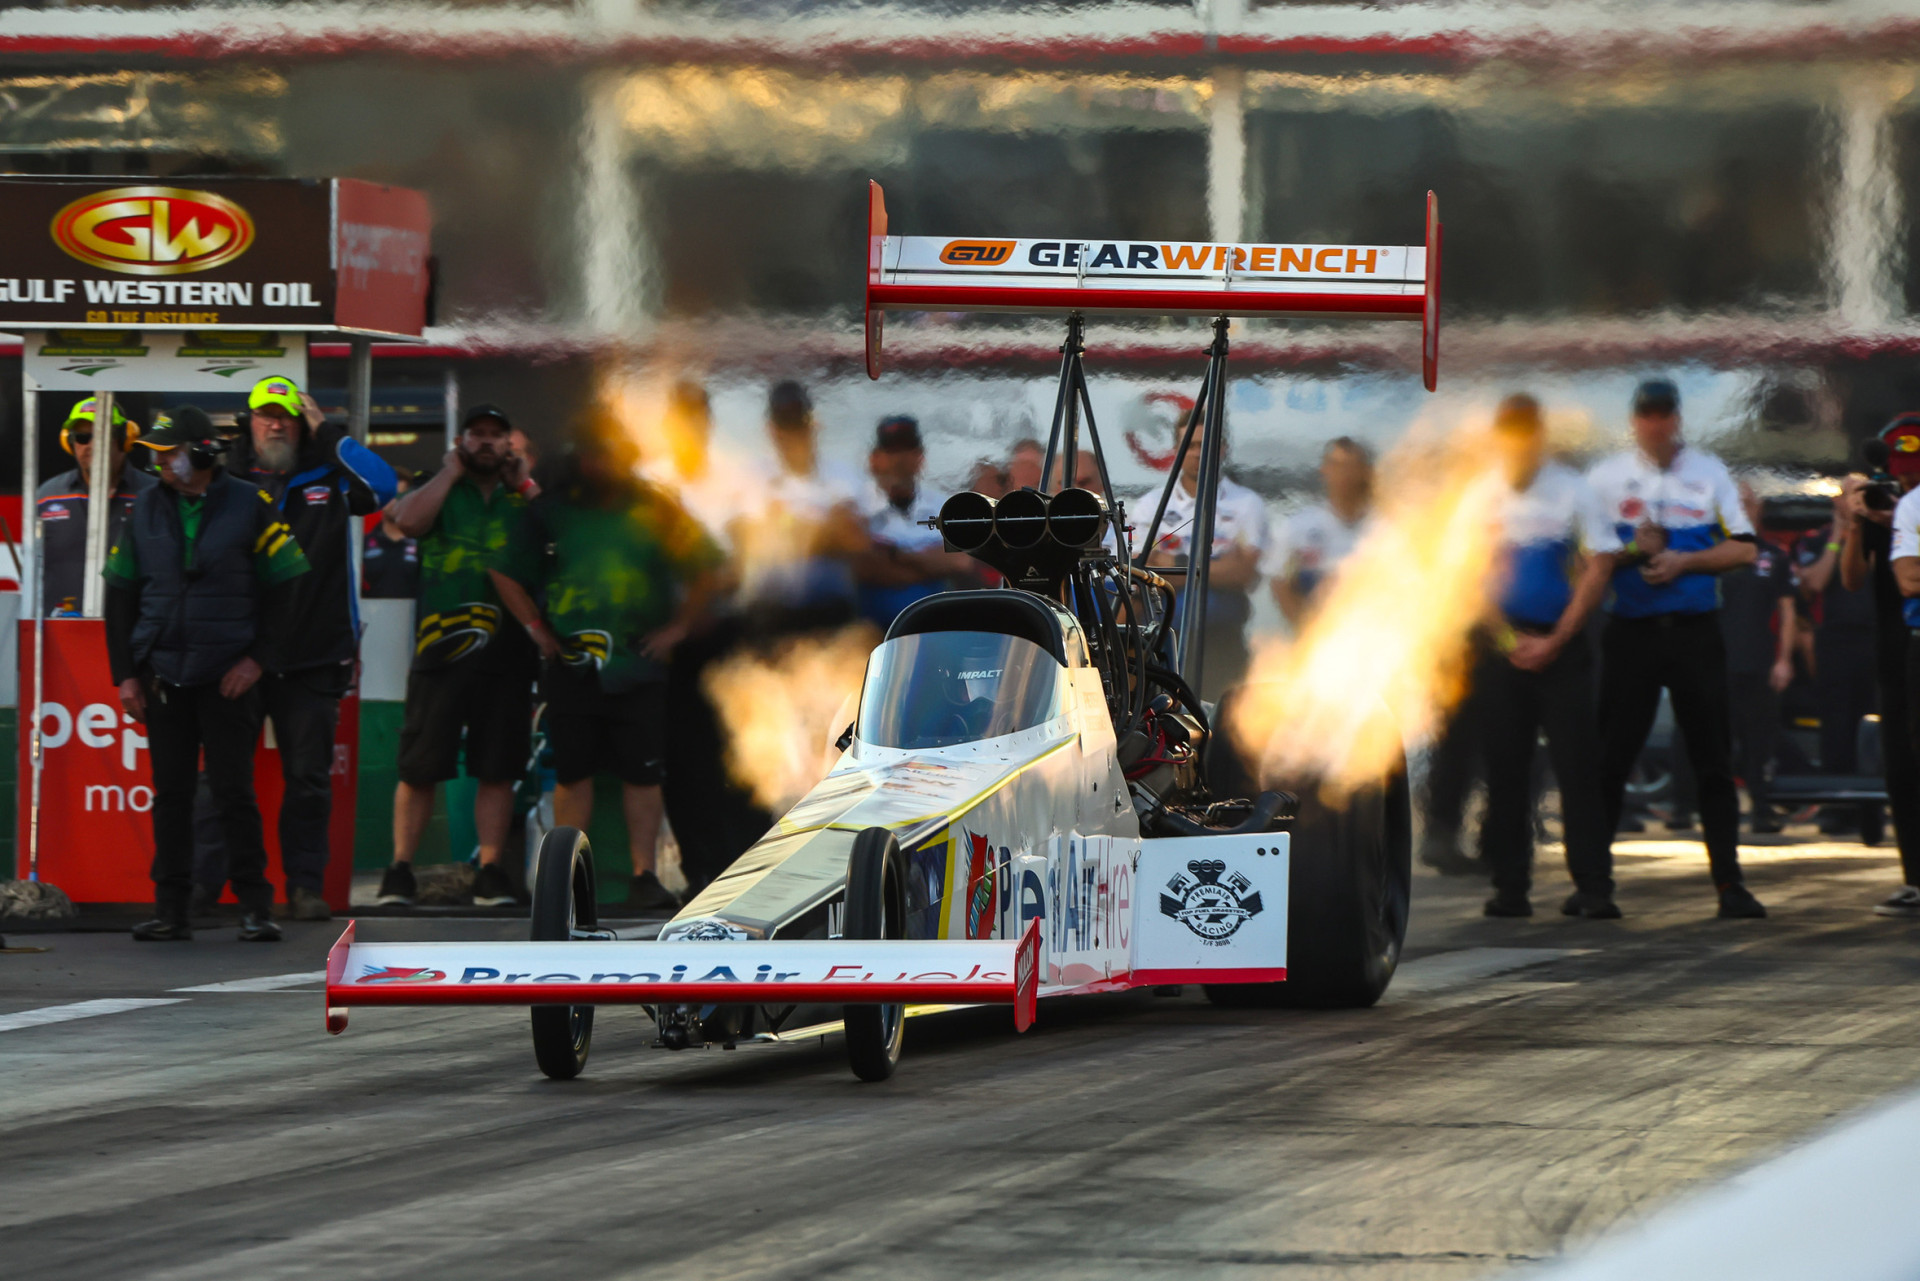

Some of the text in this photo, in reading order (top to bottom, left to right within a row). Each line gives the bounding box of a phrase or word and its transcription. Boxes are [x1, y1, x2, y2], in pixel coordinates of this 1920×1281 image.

[71, 200, 232, 262] GW
[83, 280, 252, 306] WESTERN
[262, 281, 321, 307] OIL
[111, 311, 141, 323] THE
[144, 311, 219, 324] DISTANCE
[957, 669, 1004, 680] IMPACT
[30, 701, 150, 772] pep
[85, 785, 154, 812] mo
[1191, 888, 1231, 902] PREMIAIR
[1196, 921, 1233, 935] RACING
